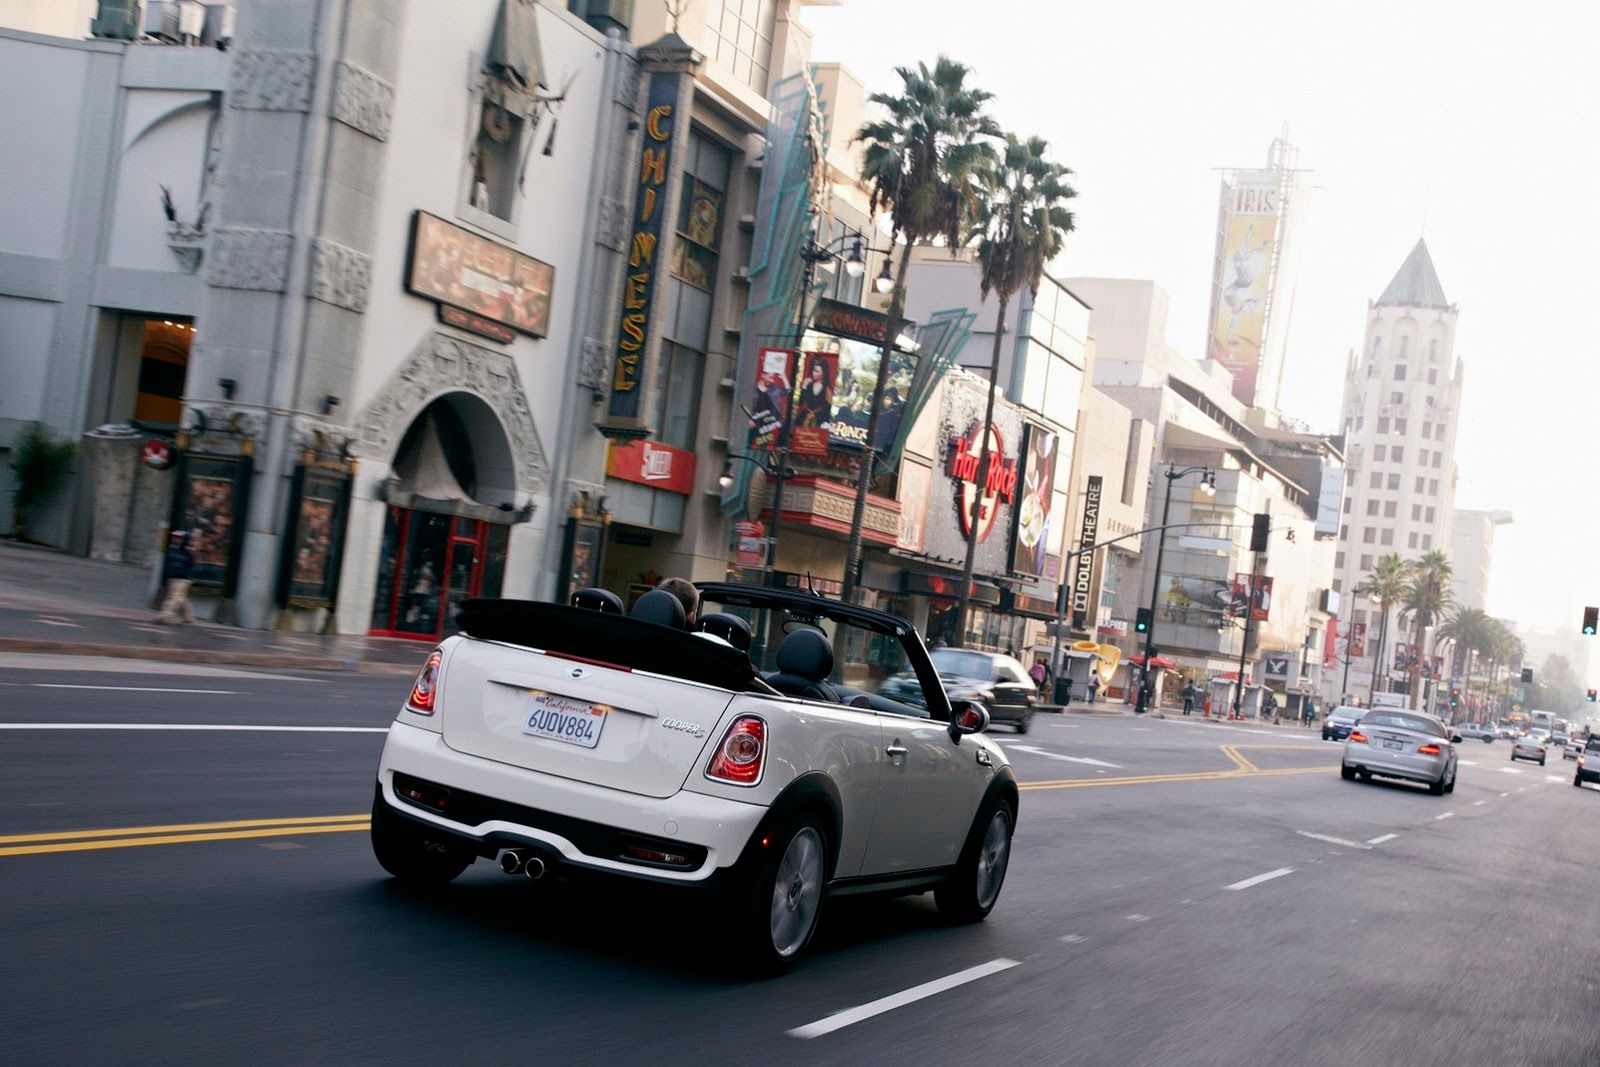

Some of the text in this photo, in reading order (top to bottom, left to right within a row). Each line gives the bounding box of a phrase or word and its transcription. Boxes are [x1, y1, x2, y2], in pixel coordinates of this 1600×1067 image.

[1235, 187, 1275, 213] IRIS
[613, 103, 674, 392] CHINESE
[986, 450, 1017, 505] Rock
[1076, 483, 1101, 592] DOLBY THEATRE
[545, 696, 589, 715] California
[662, 717, 700, 735] COOPER
